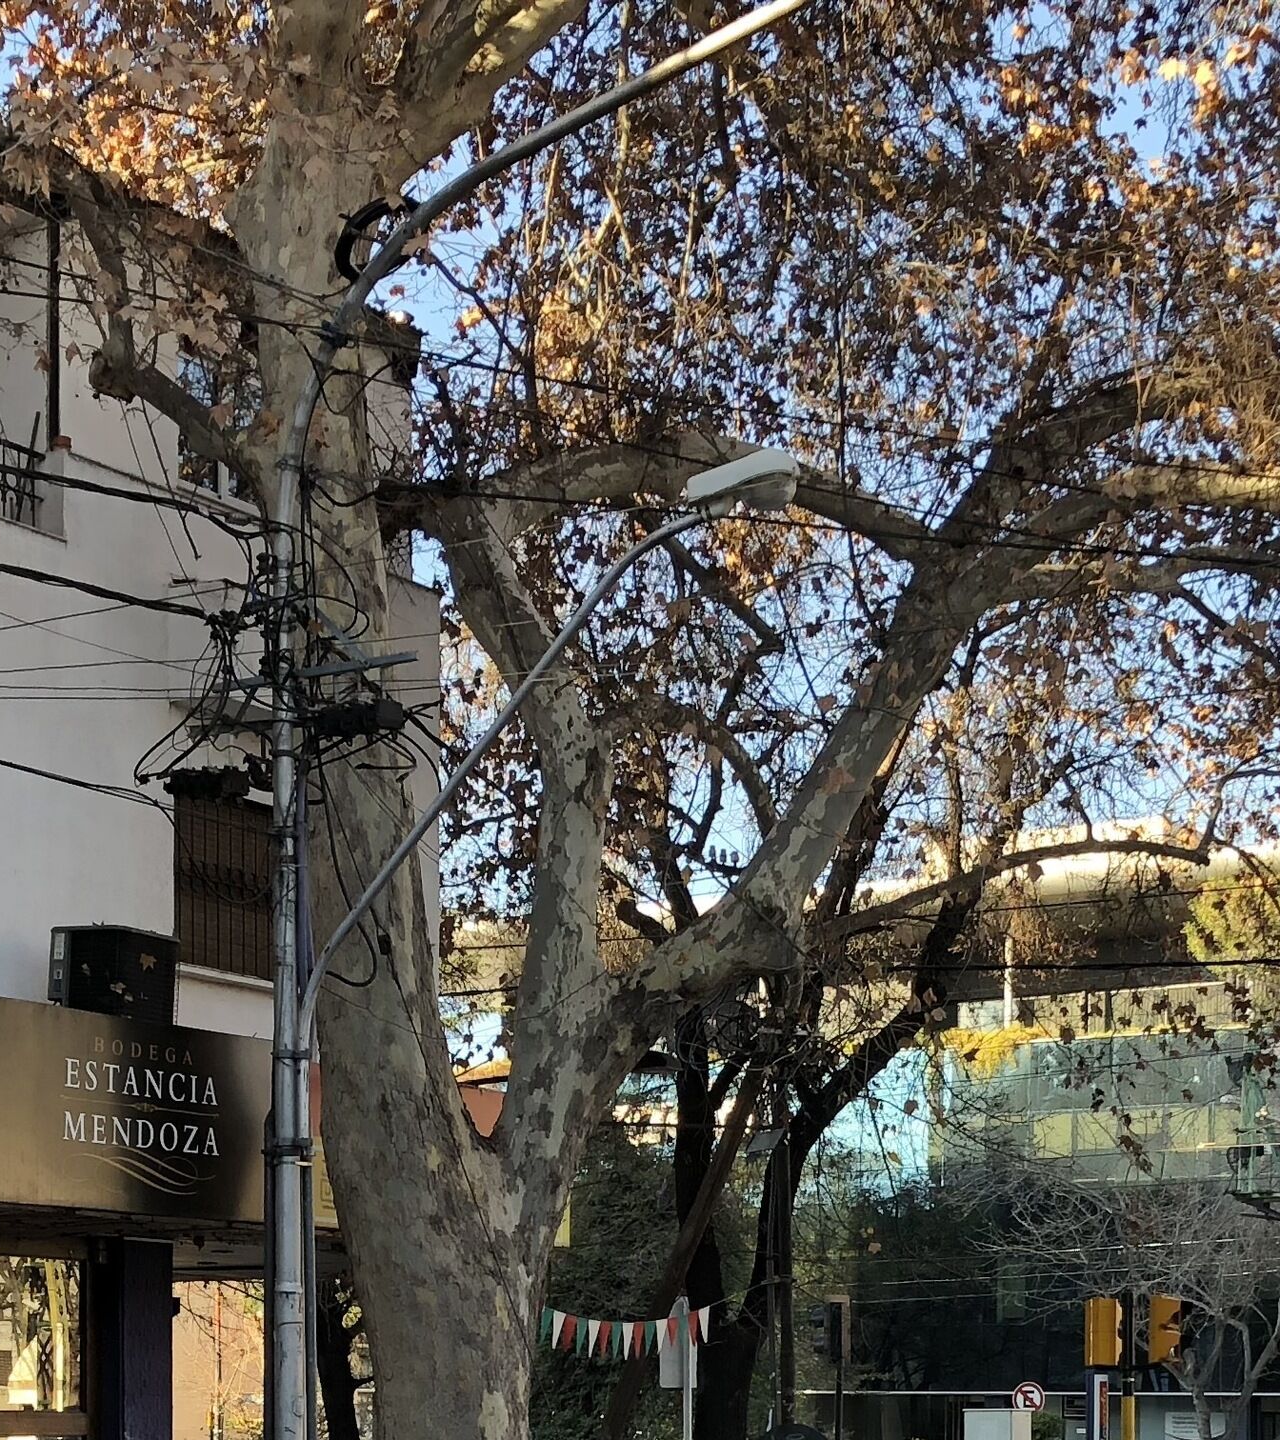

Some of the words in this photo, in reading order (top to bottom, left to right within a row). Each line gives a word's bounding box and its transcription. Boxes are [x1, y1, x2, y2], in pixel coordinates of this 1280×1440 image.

[94, 1036, 193, 1066] BODEGA
[64, 1057, 219, 1106] ESTANCIA
[62, 1110, 220, 1156] MENDOZA
